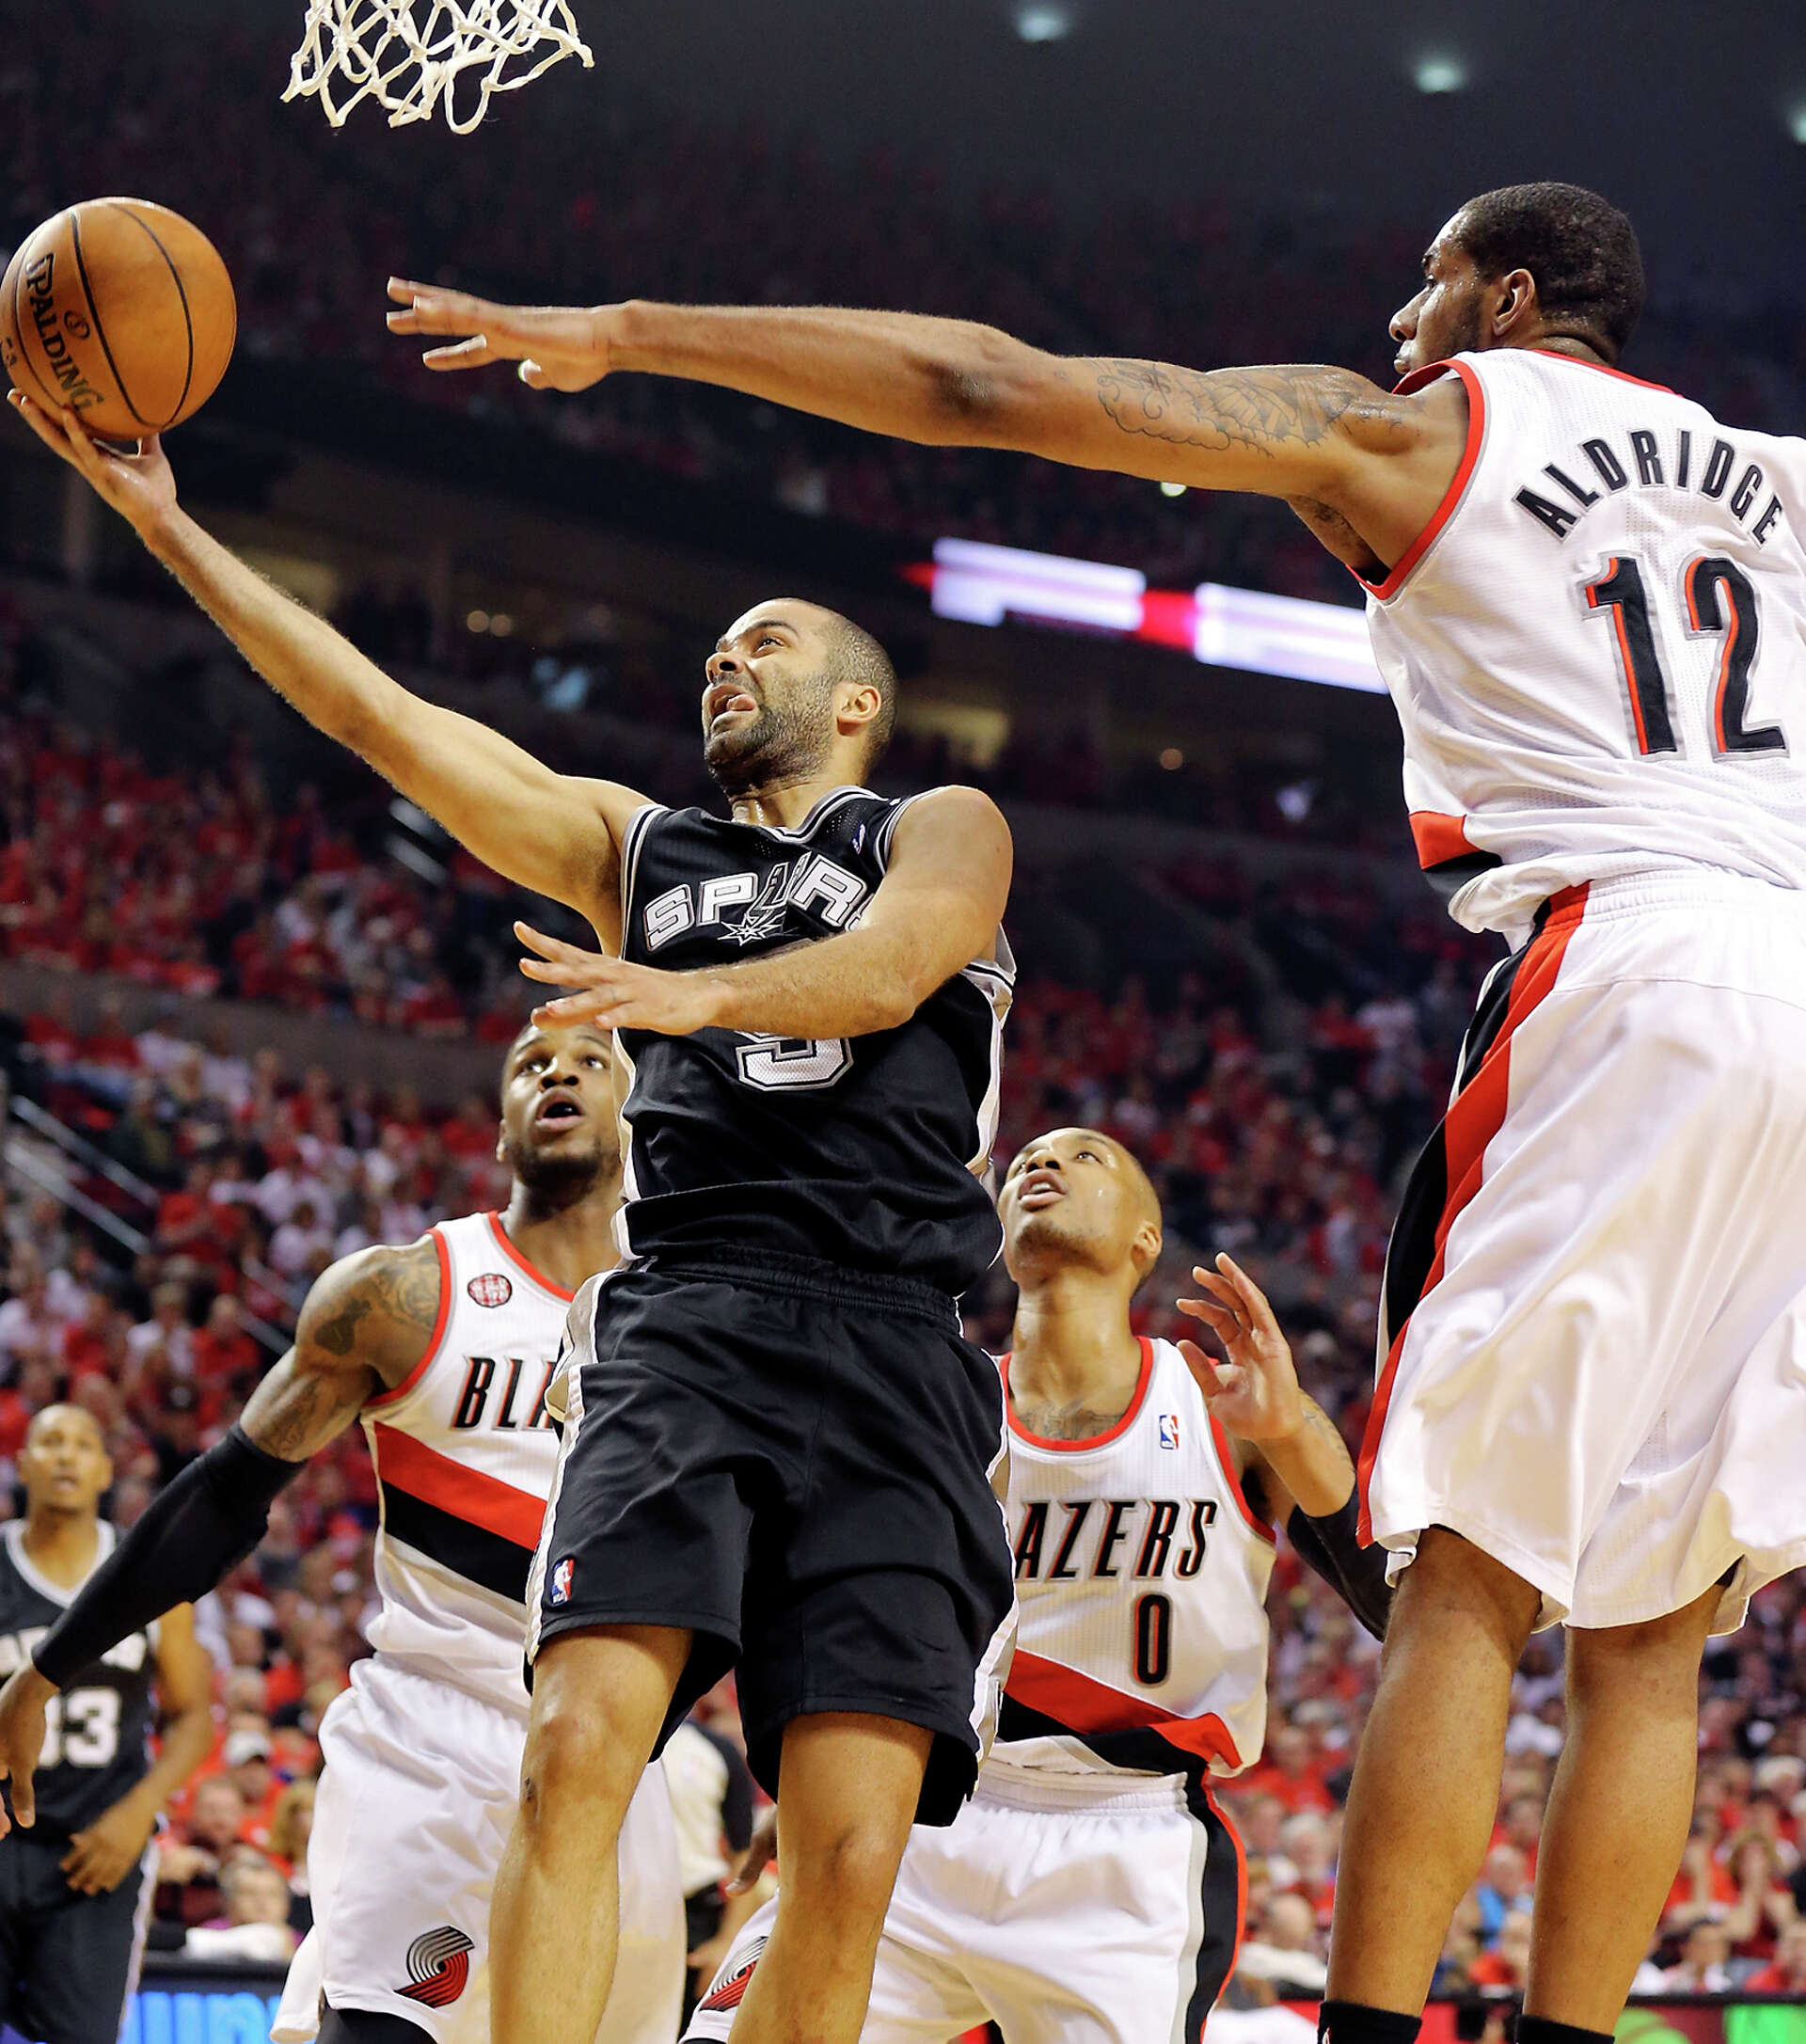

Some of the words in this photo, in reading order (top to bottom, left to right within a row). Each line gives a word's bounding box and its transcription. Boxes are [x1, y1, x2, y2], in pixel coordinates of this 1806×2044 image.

[1513, 429, 1783, 547] ALDRIDGE
[1579, 552, 1787, 758] 12
[643, 851, 872, 953] SPUR
[1133, 1592, 1173, 1686] 0
